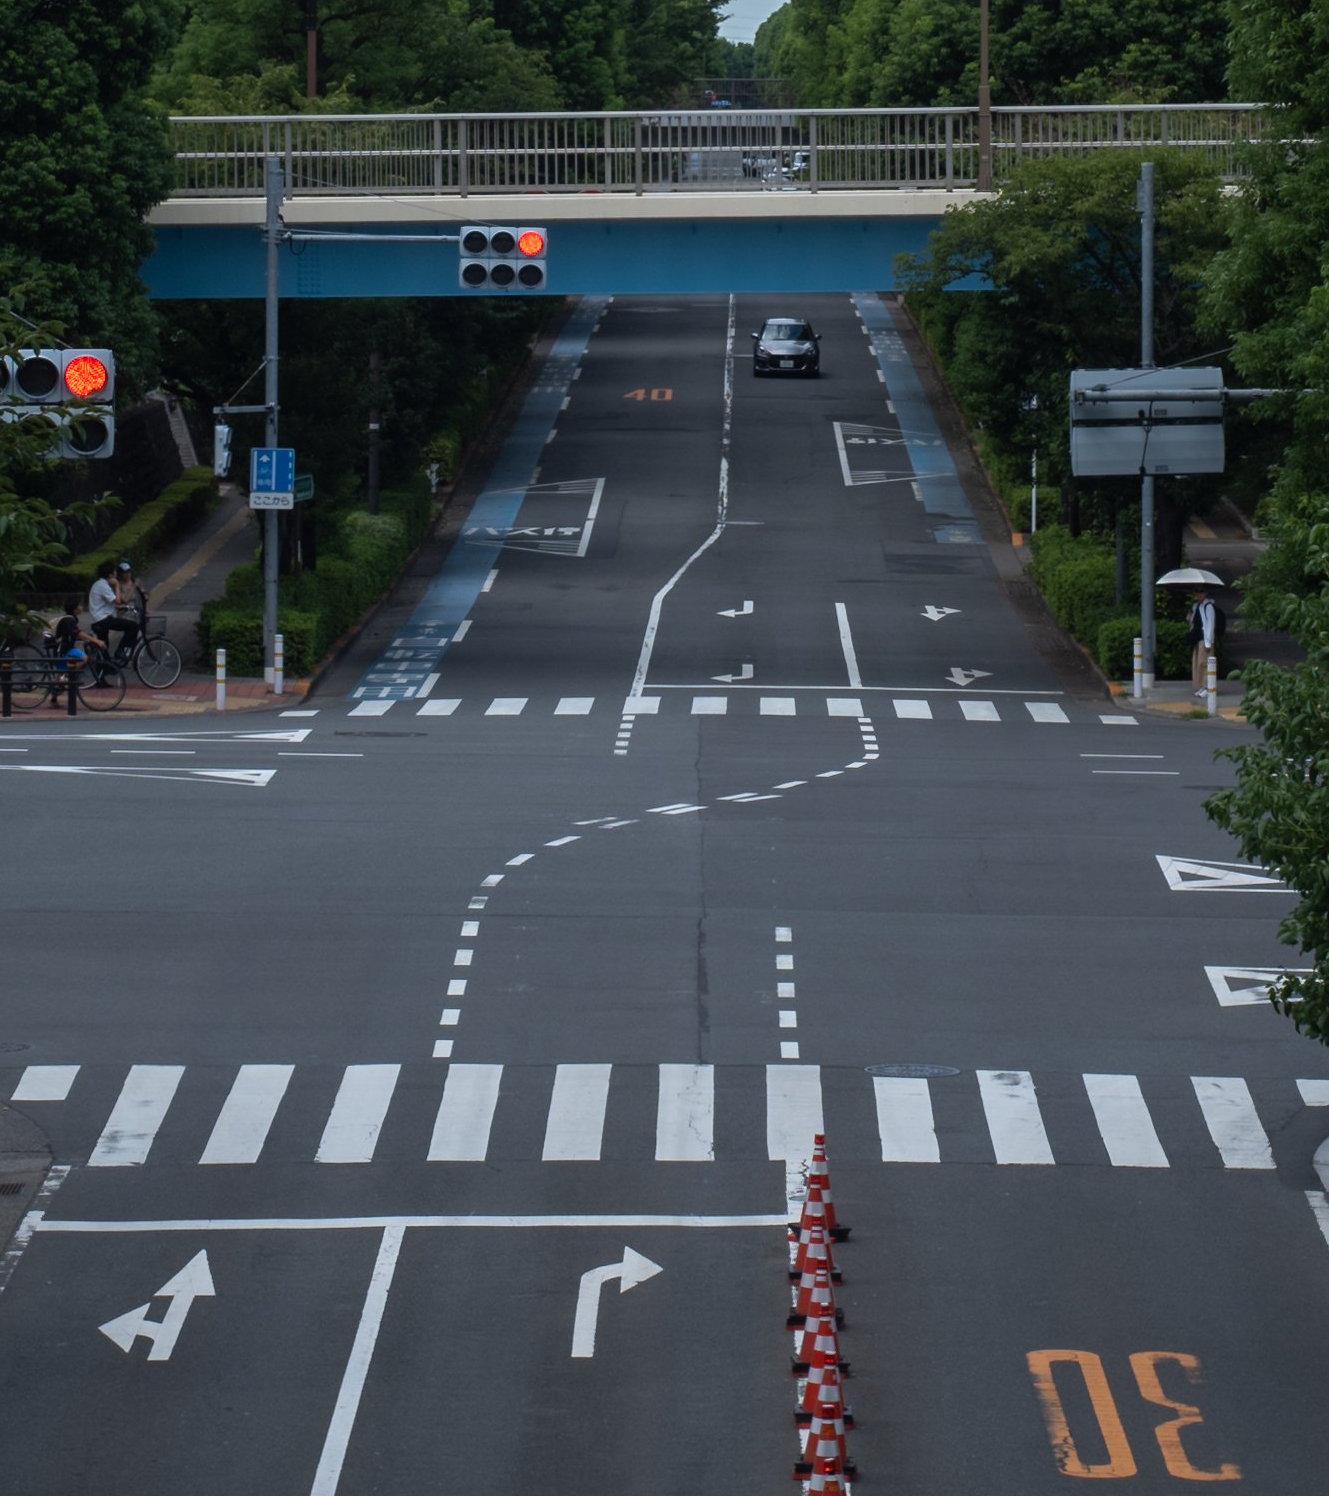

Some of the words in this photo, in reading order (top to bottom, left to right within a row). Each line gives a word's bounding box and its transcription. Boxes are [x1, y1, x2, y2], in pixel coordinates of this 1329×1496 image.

[623, 389, 673, 401] 40
[253, 496, 290, 506] ここから
[1026, 1349, 1244, 1481] 30
